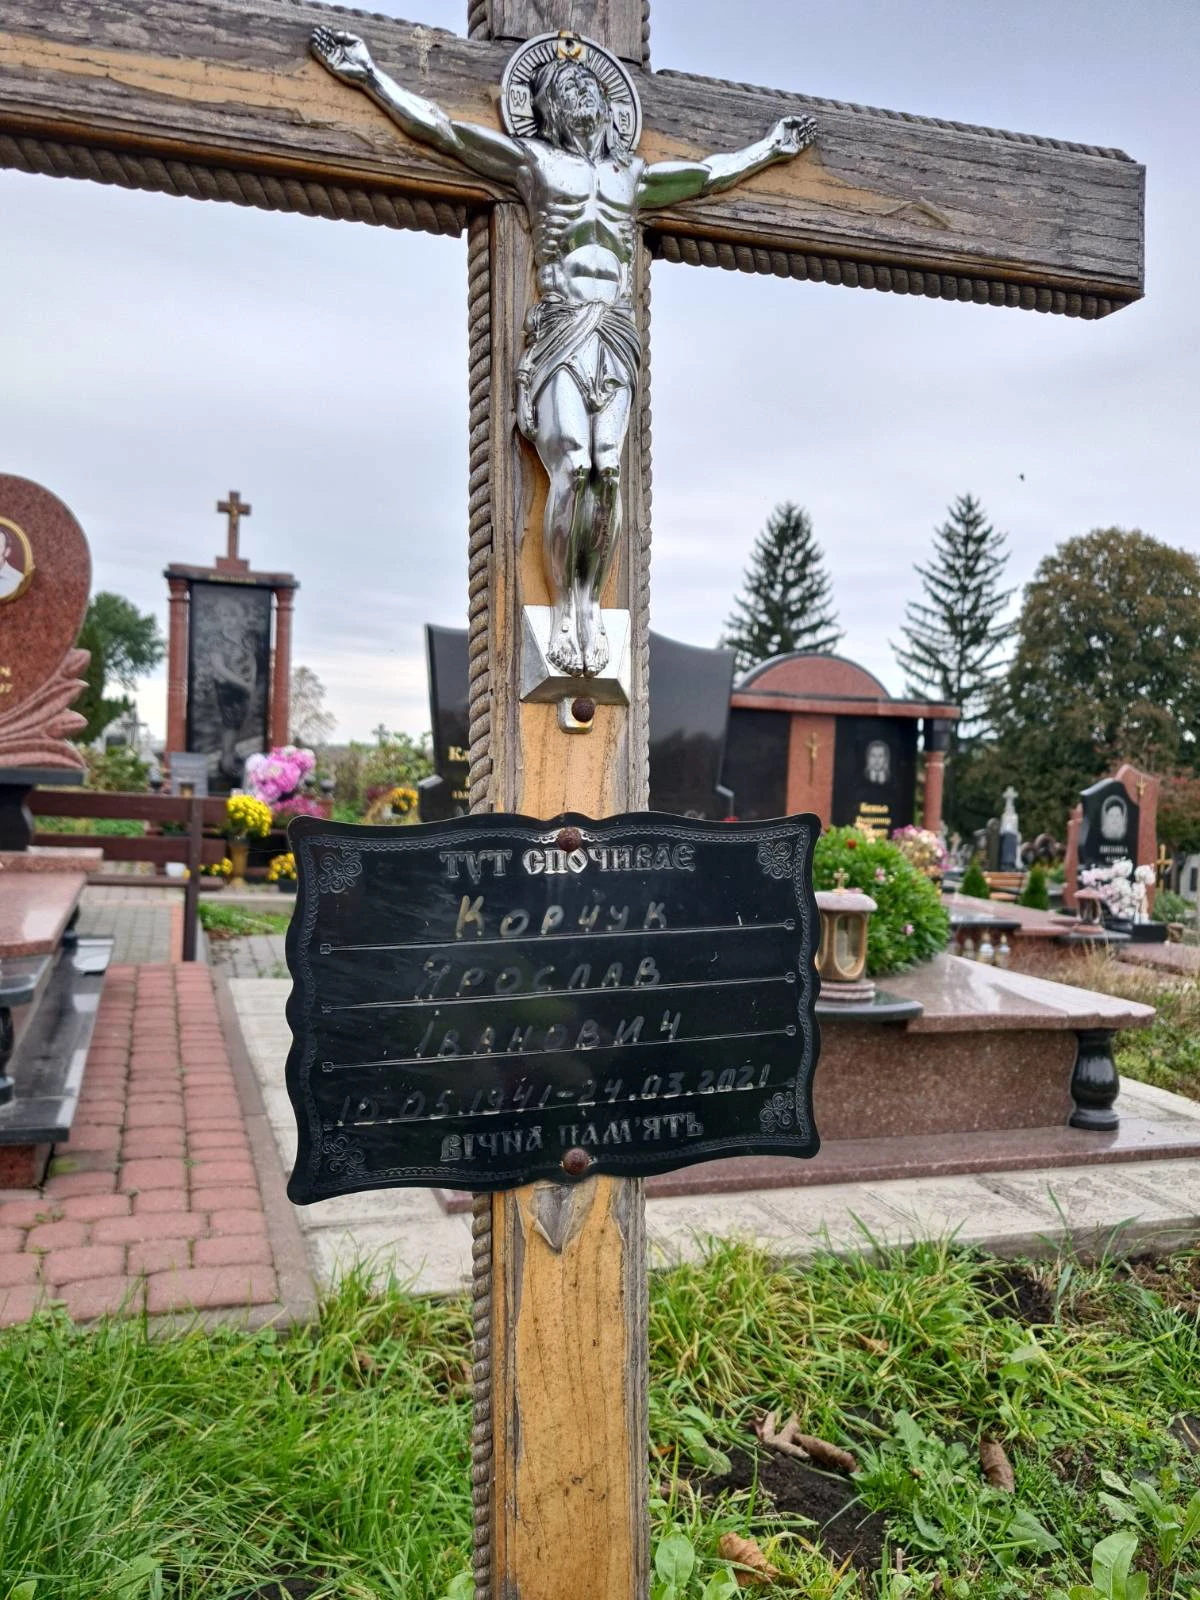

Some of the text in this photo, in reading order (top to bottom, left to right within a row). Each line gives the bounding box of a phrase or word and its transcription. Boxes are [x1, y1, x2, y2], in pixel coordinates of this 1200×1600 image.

[439, 843, 696, 885] ТУТ СПОЧИВАЄ
[454, 895, 668, 939] КОРЧУК
[413, 954, 662, 1000] ЯРОСЛАВ
[439, 1125, 544, 1162] ВІЧНА
